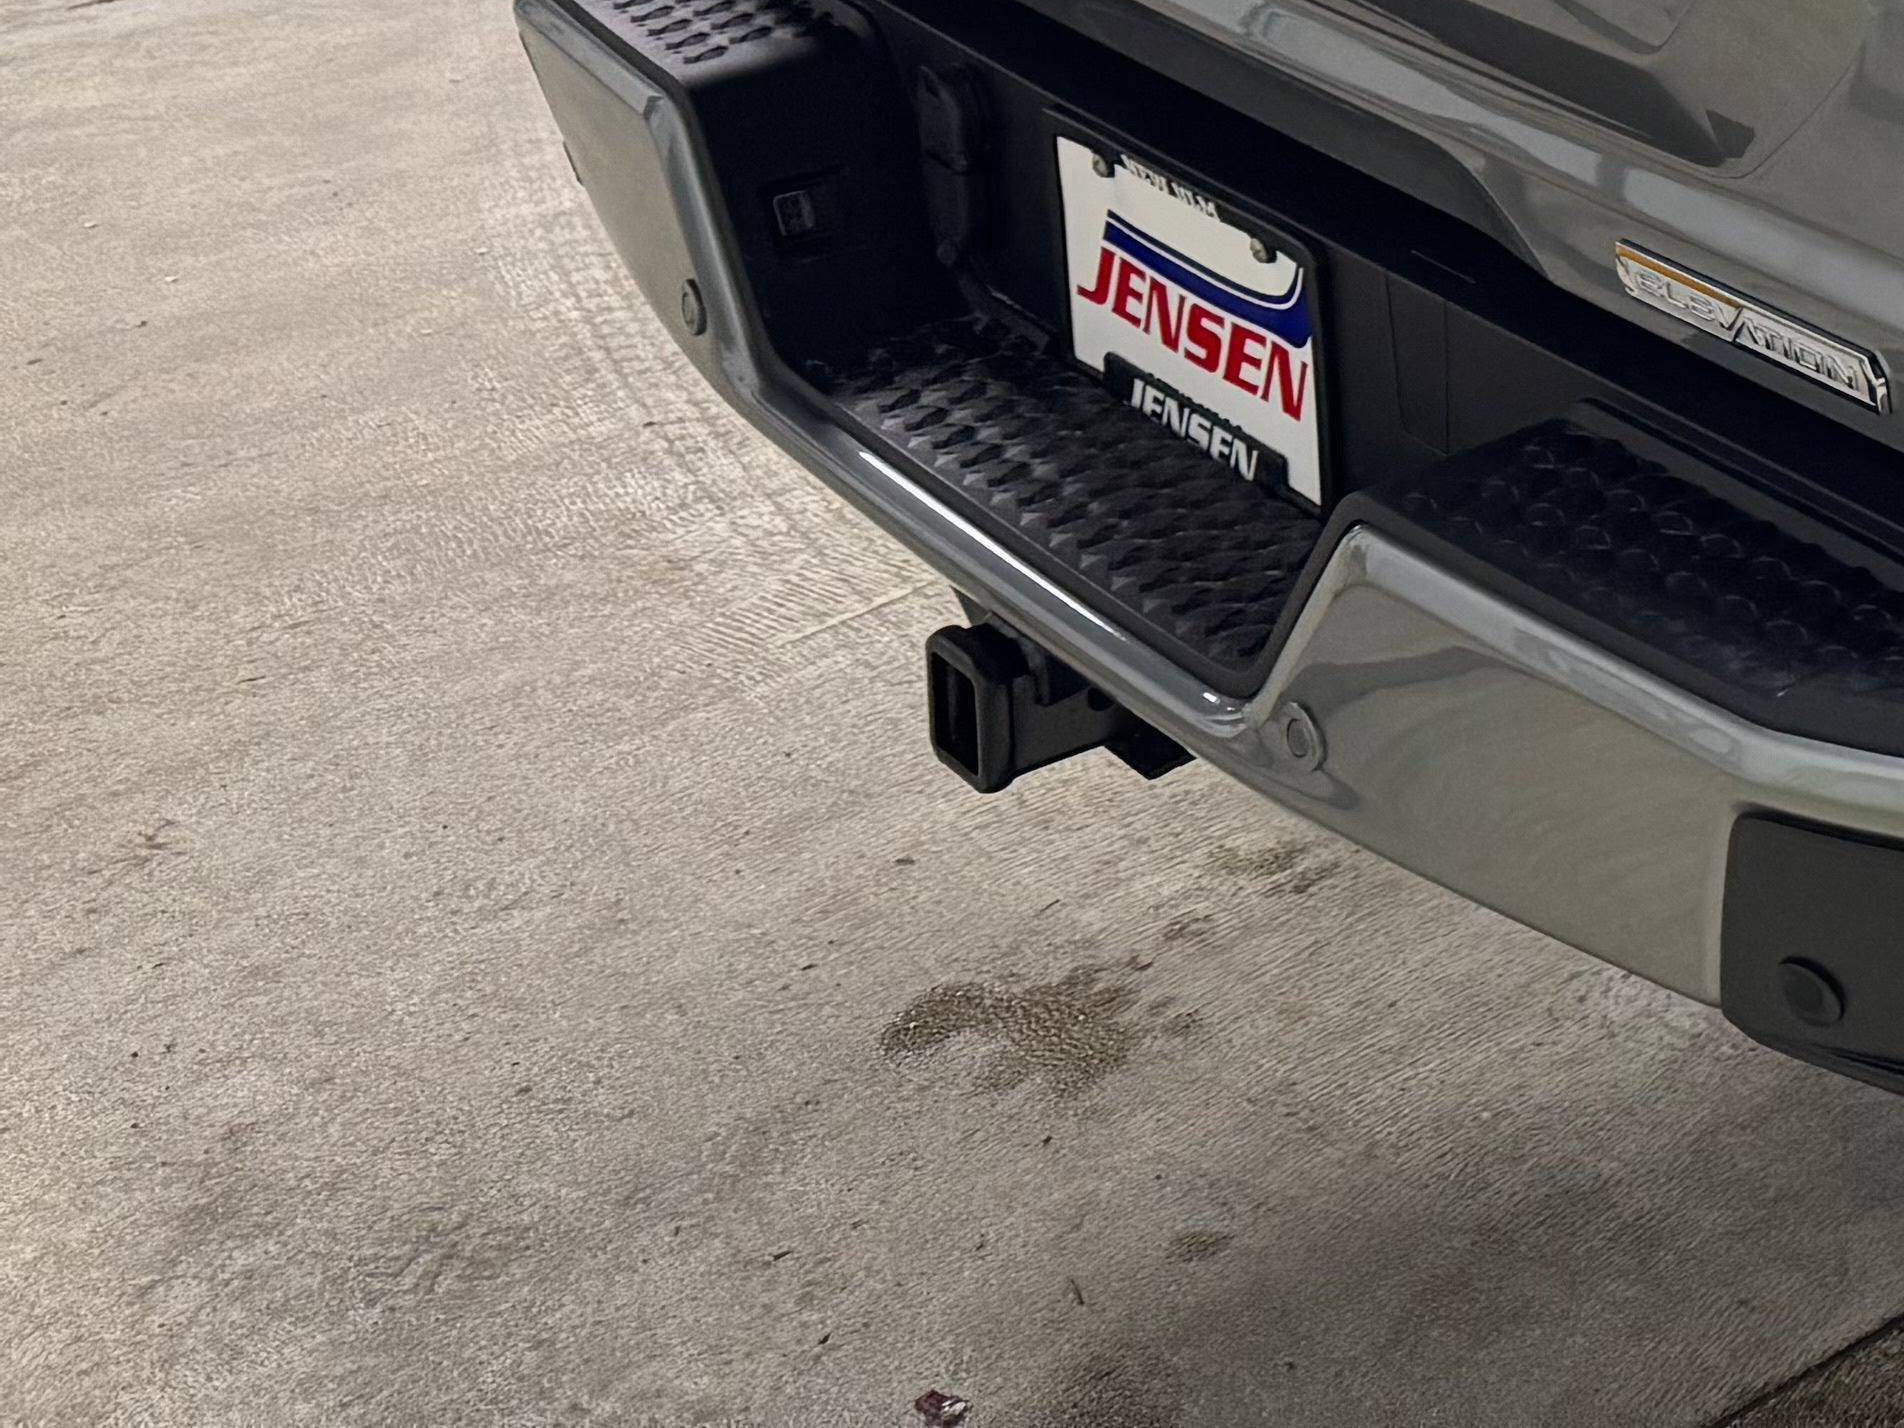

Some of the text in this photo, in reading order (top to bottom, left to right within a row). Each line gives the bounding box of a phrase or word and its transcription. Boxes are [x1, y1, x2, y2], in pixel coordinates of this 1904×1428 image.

[1077, 246, 1308, 422] JENSEN
[1636, 269, 1860, 392] ELEVATION
[1126, 377, 1259, 482] JENSEN
